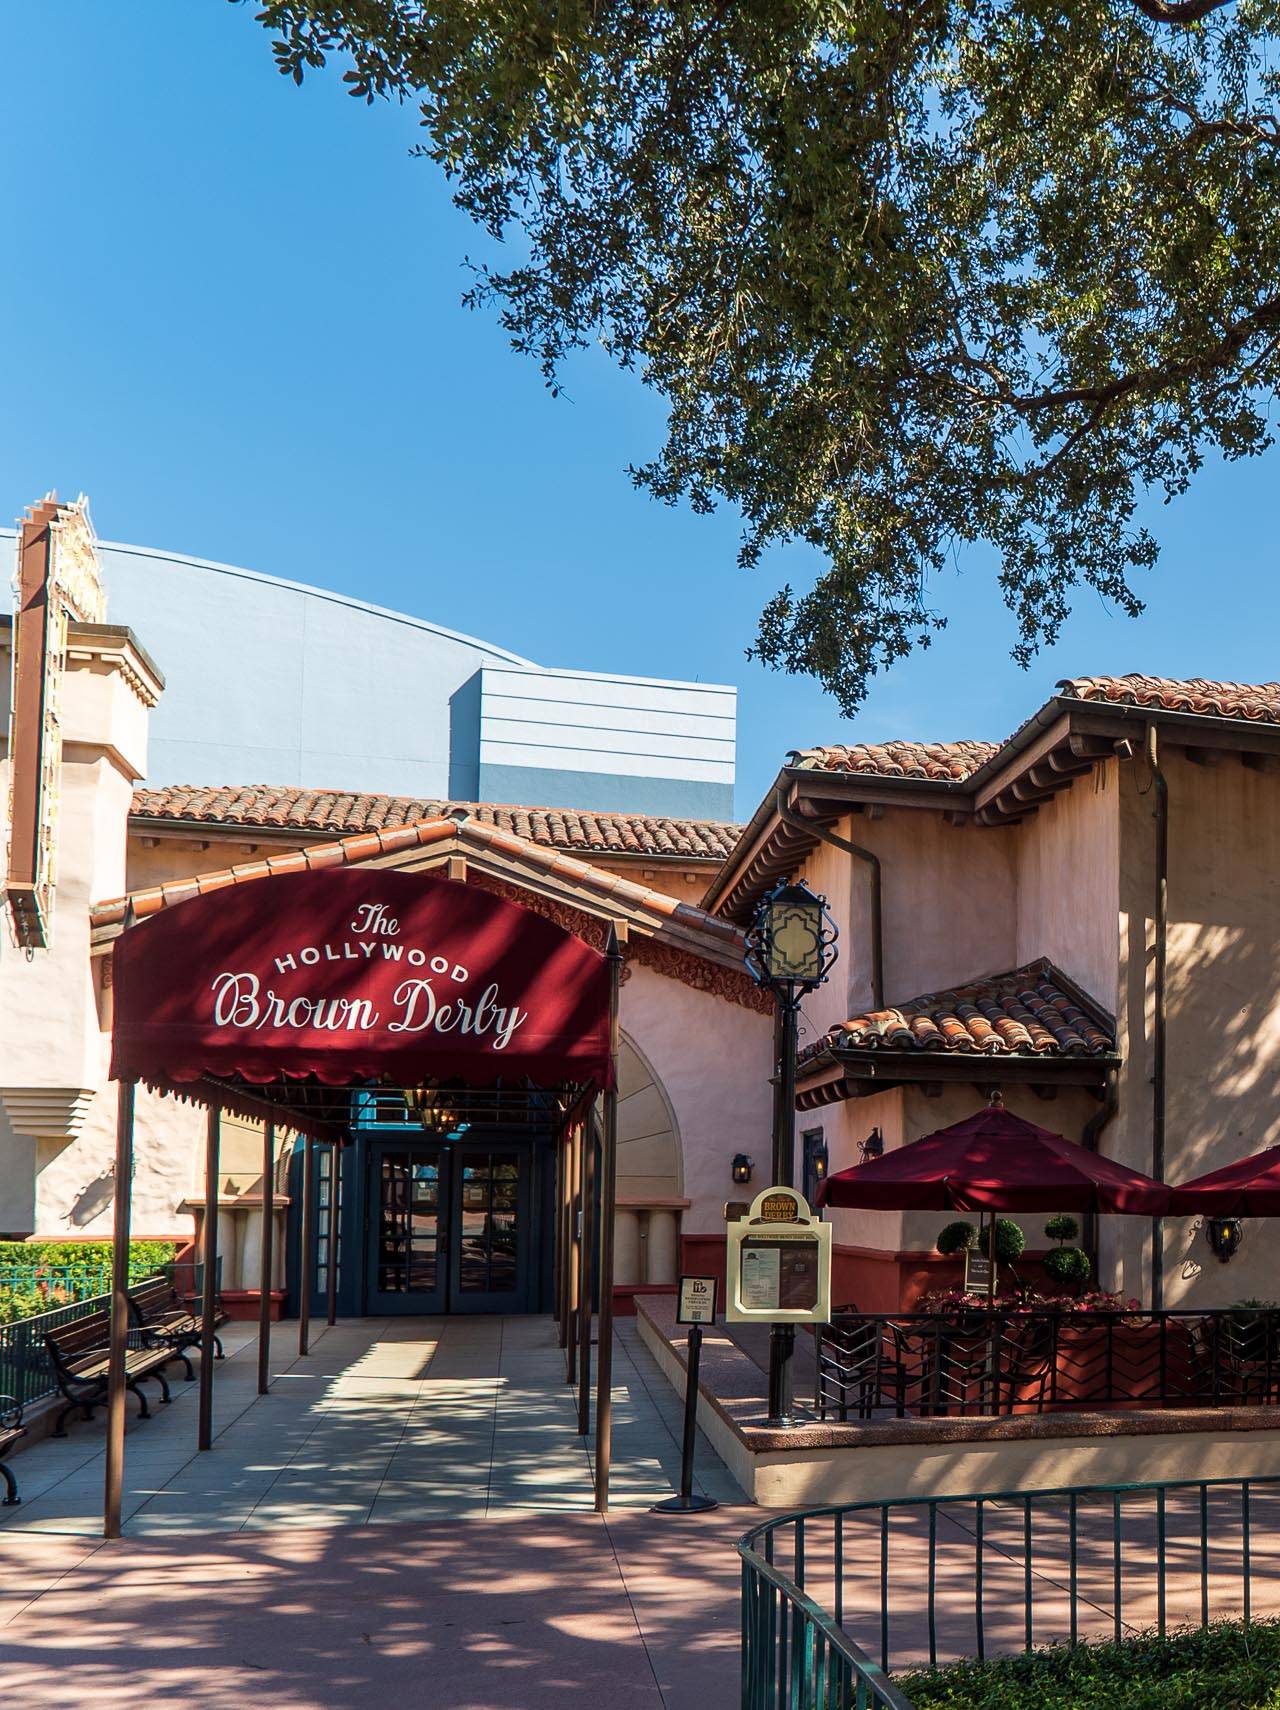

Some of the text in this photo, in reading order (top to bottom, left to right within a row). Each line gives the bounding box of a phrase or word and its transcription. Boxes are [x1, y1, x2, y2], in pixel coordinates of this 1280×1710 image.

[351, 903, 401, 936] The
[274, 941, 470, 983] HOLLYWOOD
[211, 972, 528, 1050] Brown Derby
[764, 1202, 796, 1211] BROWN
